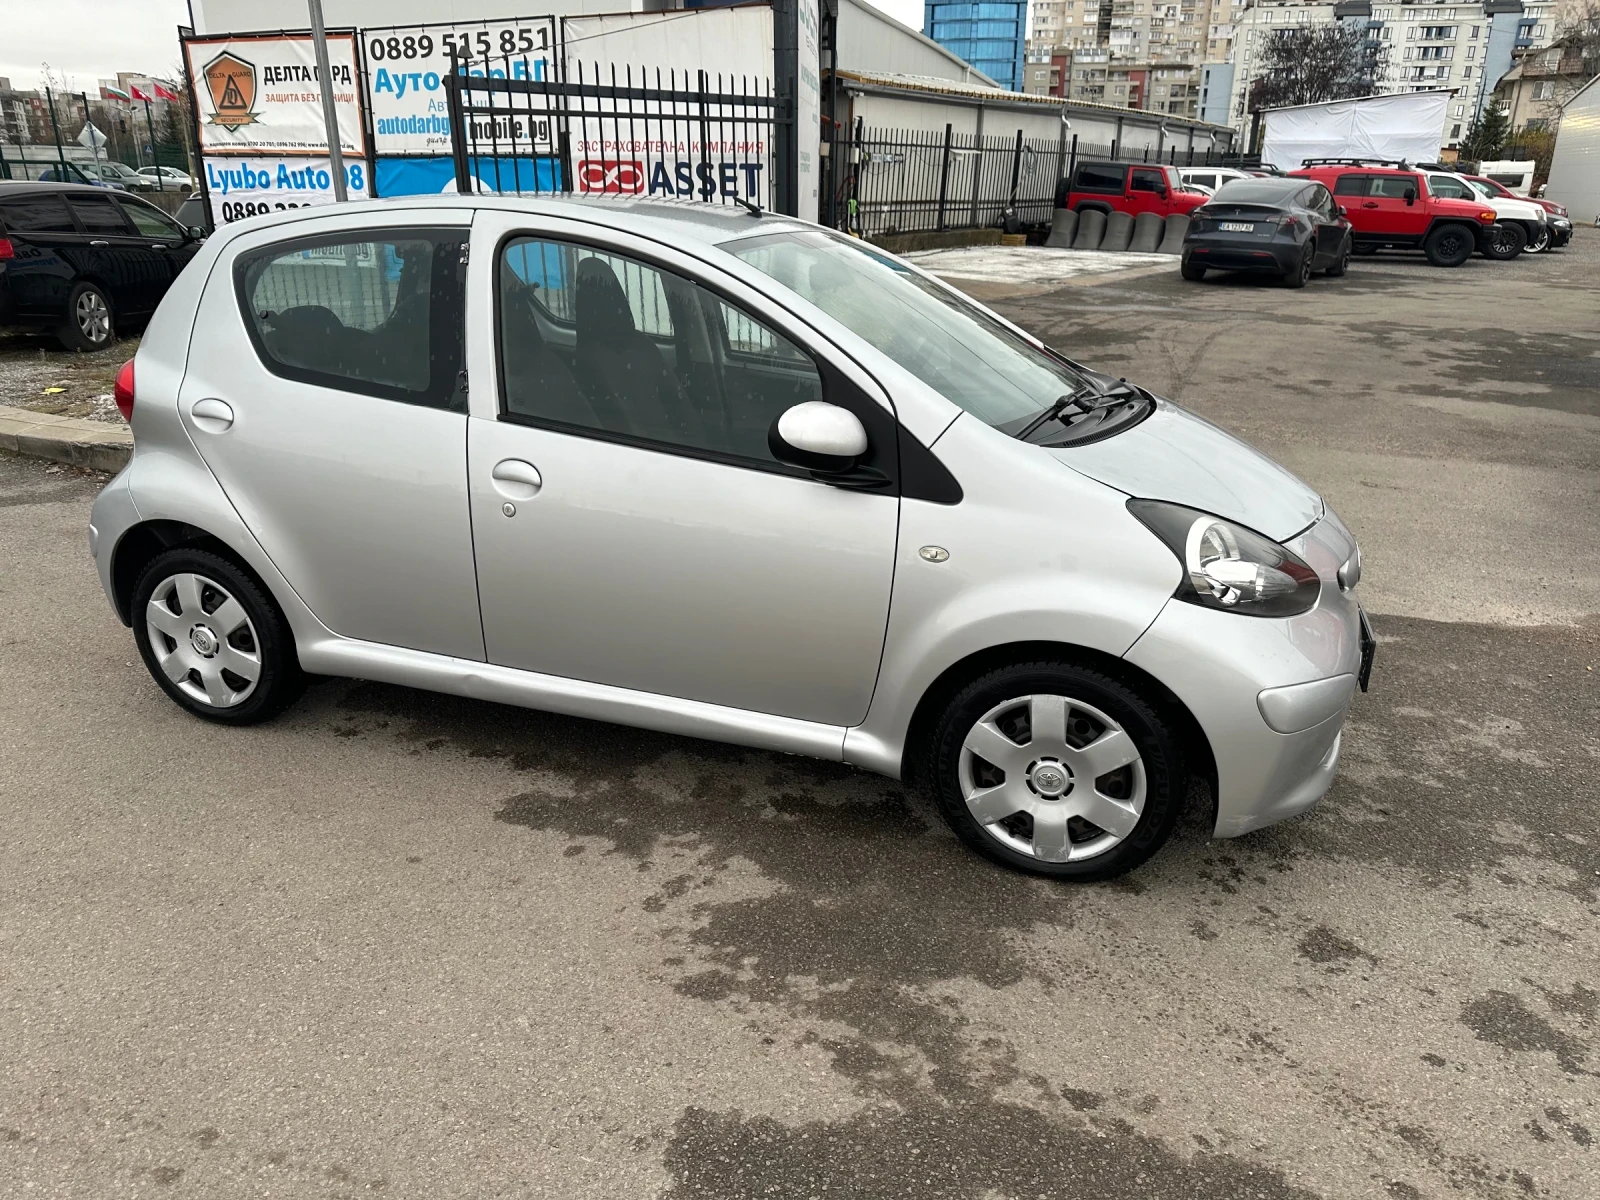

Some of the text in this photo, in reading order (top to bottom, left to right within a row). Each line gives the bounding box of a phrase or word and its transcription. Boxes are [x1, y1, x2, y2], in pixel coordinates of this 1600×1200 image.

[370, 27, 549, 61] 0889 515 851
[264, 65, 352, 85] ДЕЛТА ГРД
[375, 67, 440, 100] Ауто
[265, 93, 354, 104] ЗАЩИТА БЕЗ ГНИЦИ
[377, 113, 548, 141] autodarbg mobile.bg
[207, 162, 271, 196] Lyubo
[277, 163, 330, 191] Auto
[650, 161, 764, 198] ASSET
